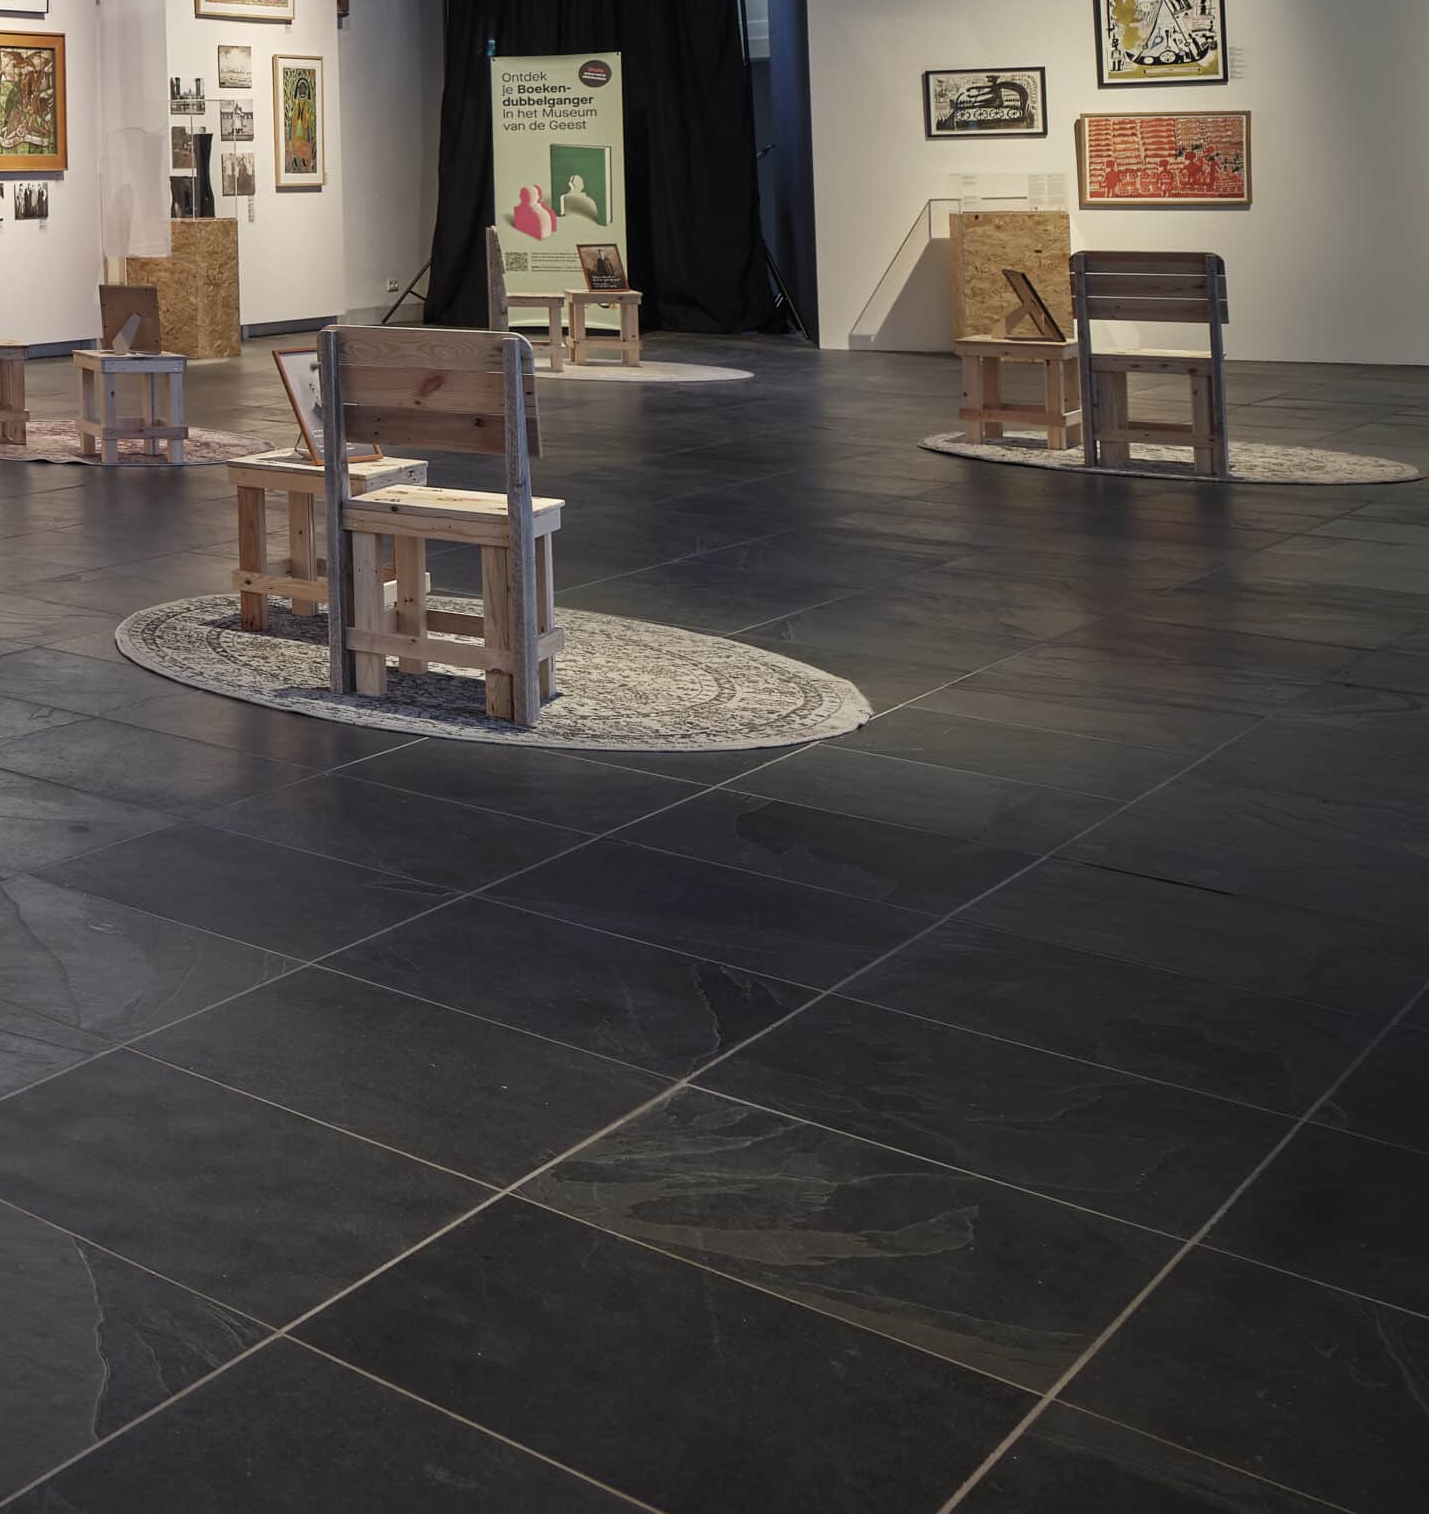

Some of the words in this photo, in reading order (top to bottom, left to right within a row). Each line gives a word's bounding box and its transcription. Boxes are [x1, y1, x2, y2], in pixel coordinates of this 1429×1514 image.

[501, 72, 548, 83] Ontdek
[502, 86, 514, 96] je
[517, 83, 572, 94] Boeken-
[502, 96, 594, 108] dubbelganger
[503, 109, 514, 119] in
[517, 108, 538, 119] het
[542, 108, 598, 118] Museum
[503, 122, 526, 131] van
[529, 120, 545, 131] de
[549, 120, 588, 131] Geest
